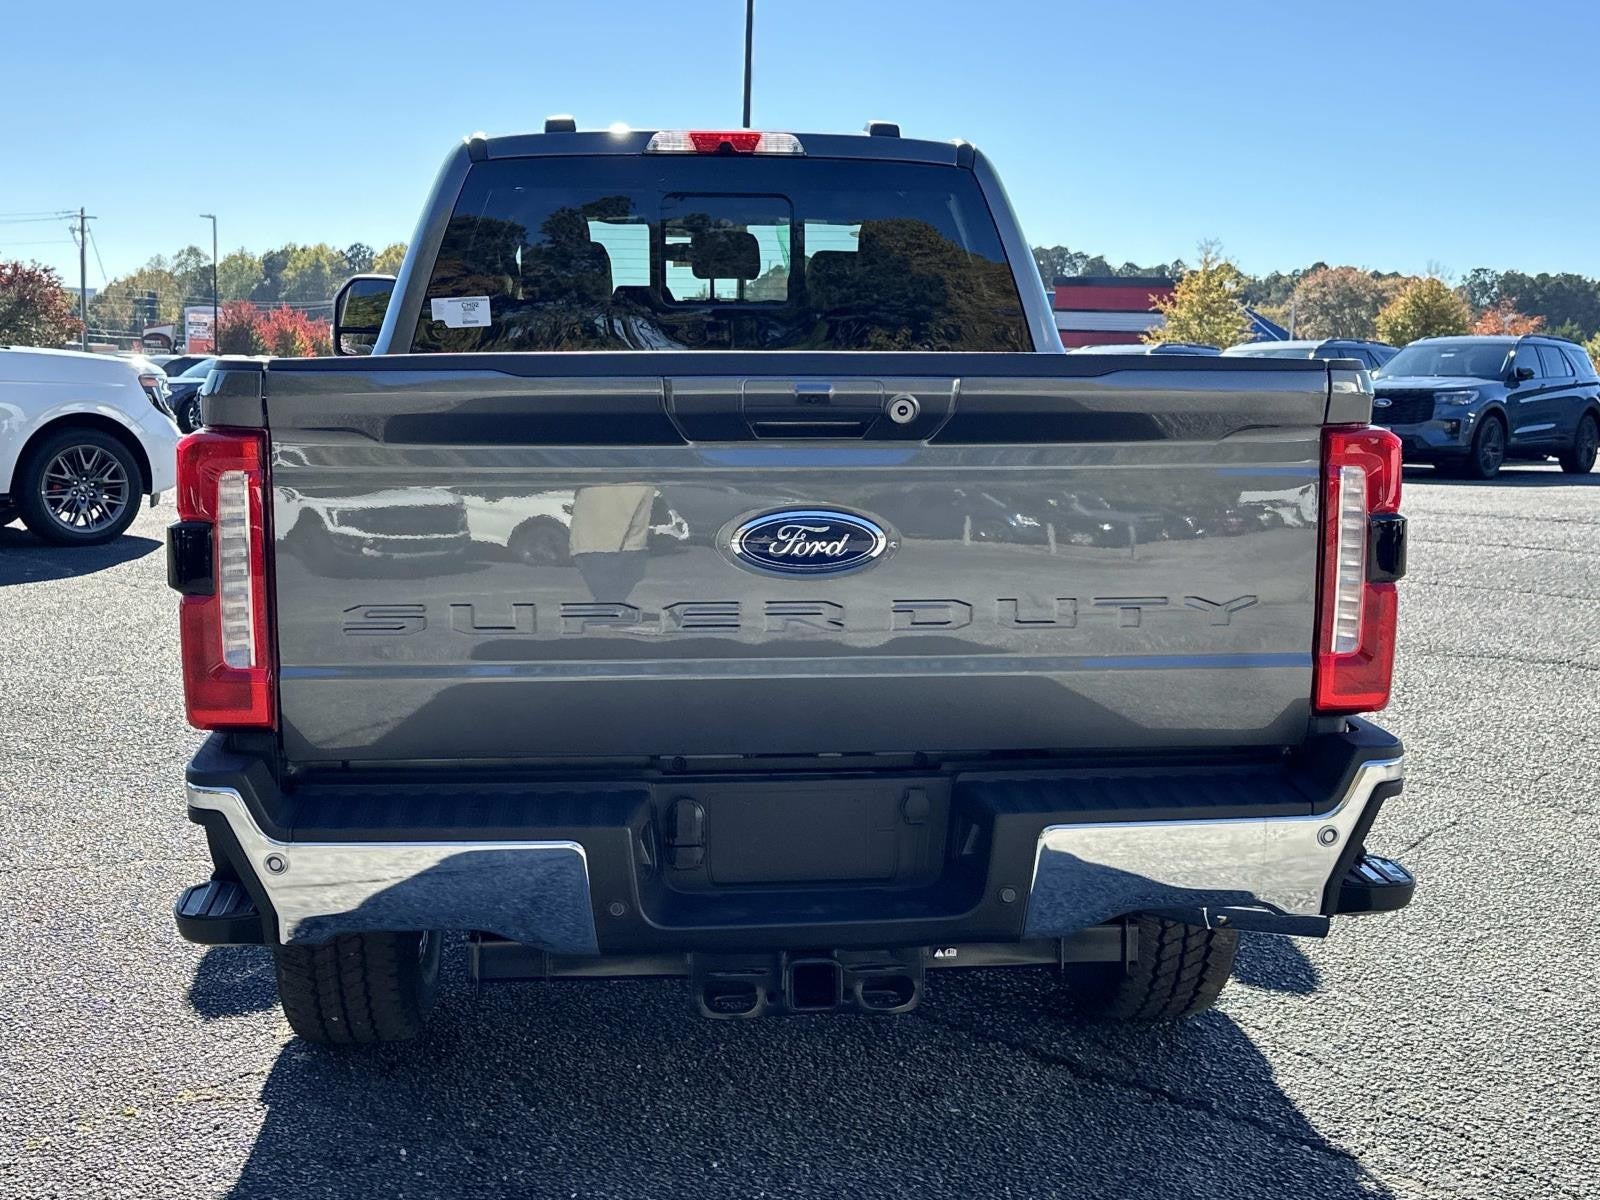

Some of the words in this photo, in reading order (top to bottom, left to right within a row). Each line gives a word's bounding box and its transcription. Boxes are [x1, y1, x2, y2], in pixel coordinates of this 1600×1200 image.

[768, 524, 850, 557] Ford
[342, 600, 846, 636] SUPER
[891, 594, 1258, 631] DUTY
